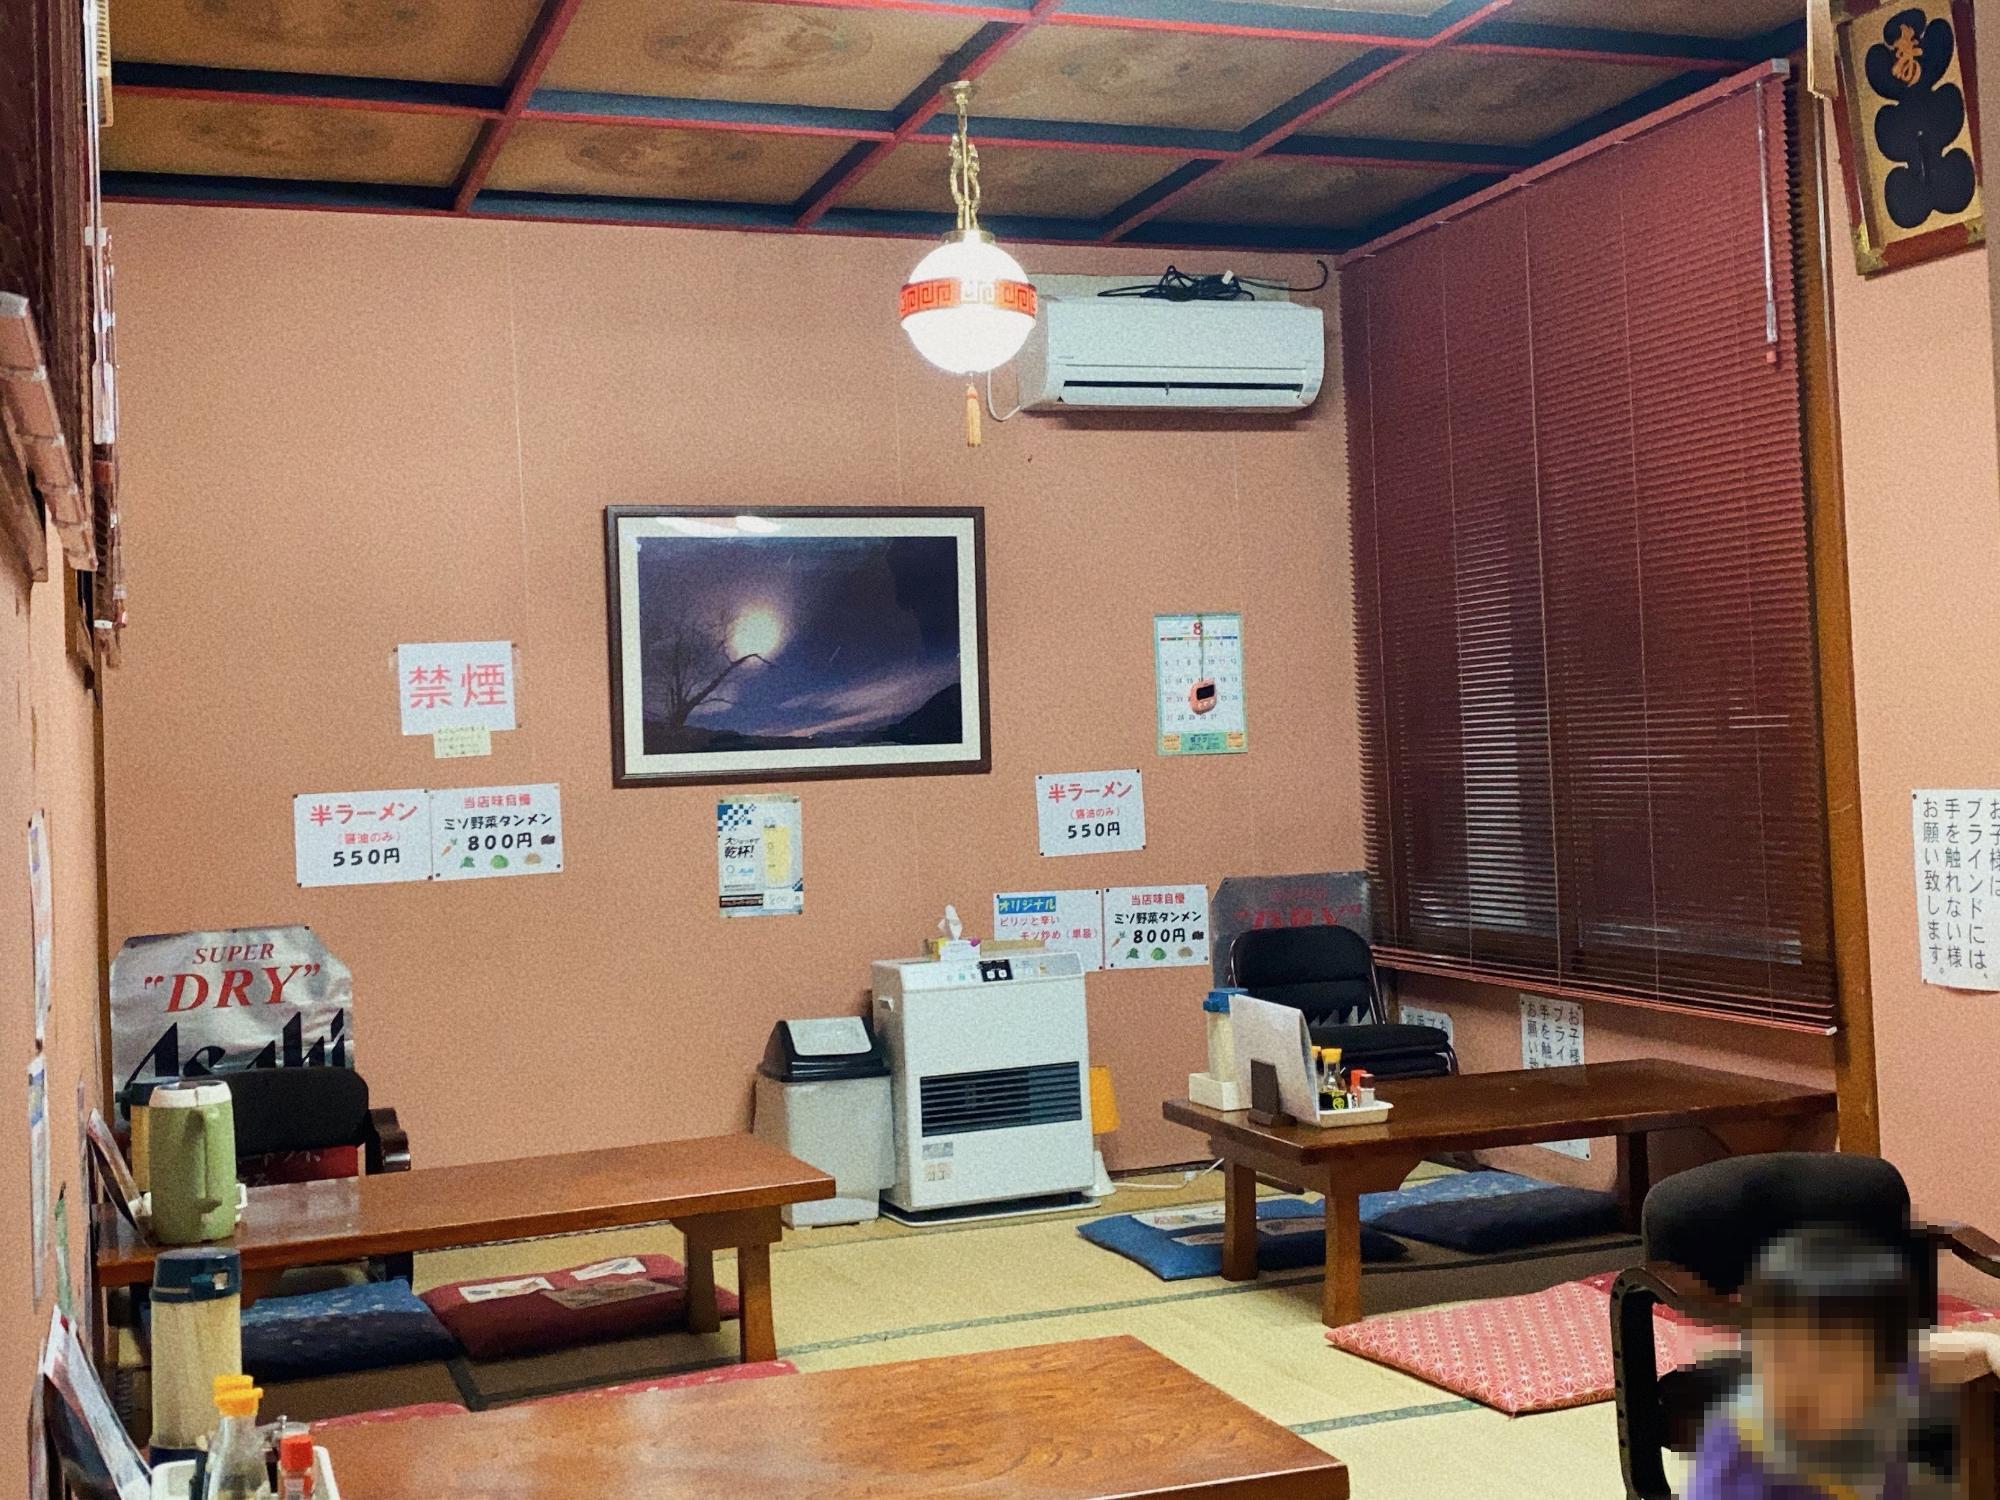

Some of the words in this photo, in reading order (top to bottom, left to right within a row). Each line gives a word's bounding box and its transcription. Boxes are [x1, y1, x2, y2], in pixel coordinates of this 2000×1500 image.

[408, 663, 508, 708] 禁煙
[463, 793, 532, 809] 当店味自慢
[1048, 781, 1132, 803] 半ラーメン
[310, 802, 418, 827] 半ラーメン
[444, 813, 552, 831] ミソ野菜タンメン
[1067, 821, 1120, 839] 550円
[468, 832, 533, 851] 800円
[333, 847, 401, 867] 550円
[1944, 798, 1962, 968] 手を触れない様
[999, 897, 1056, 913] オリジナル
[1131, 892, 1185, 906] 当店味自慢
[1114, 912, 1202, 925] ミソ野菜タンメン
[1133, 928, 1186, 944] 800円
[192, 943, 275, 965] SUPER
